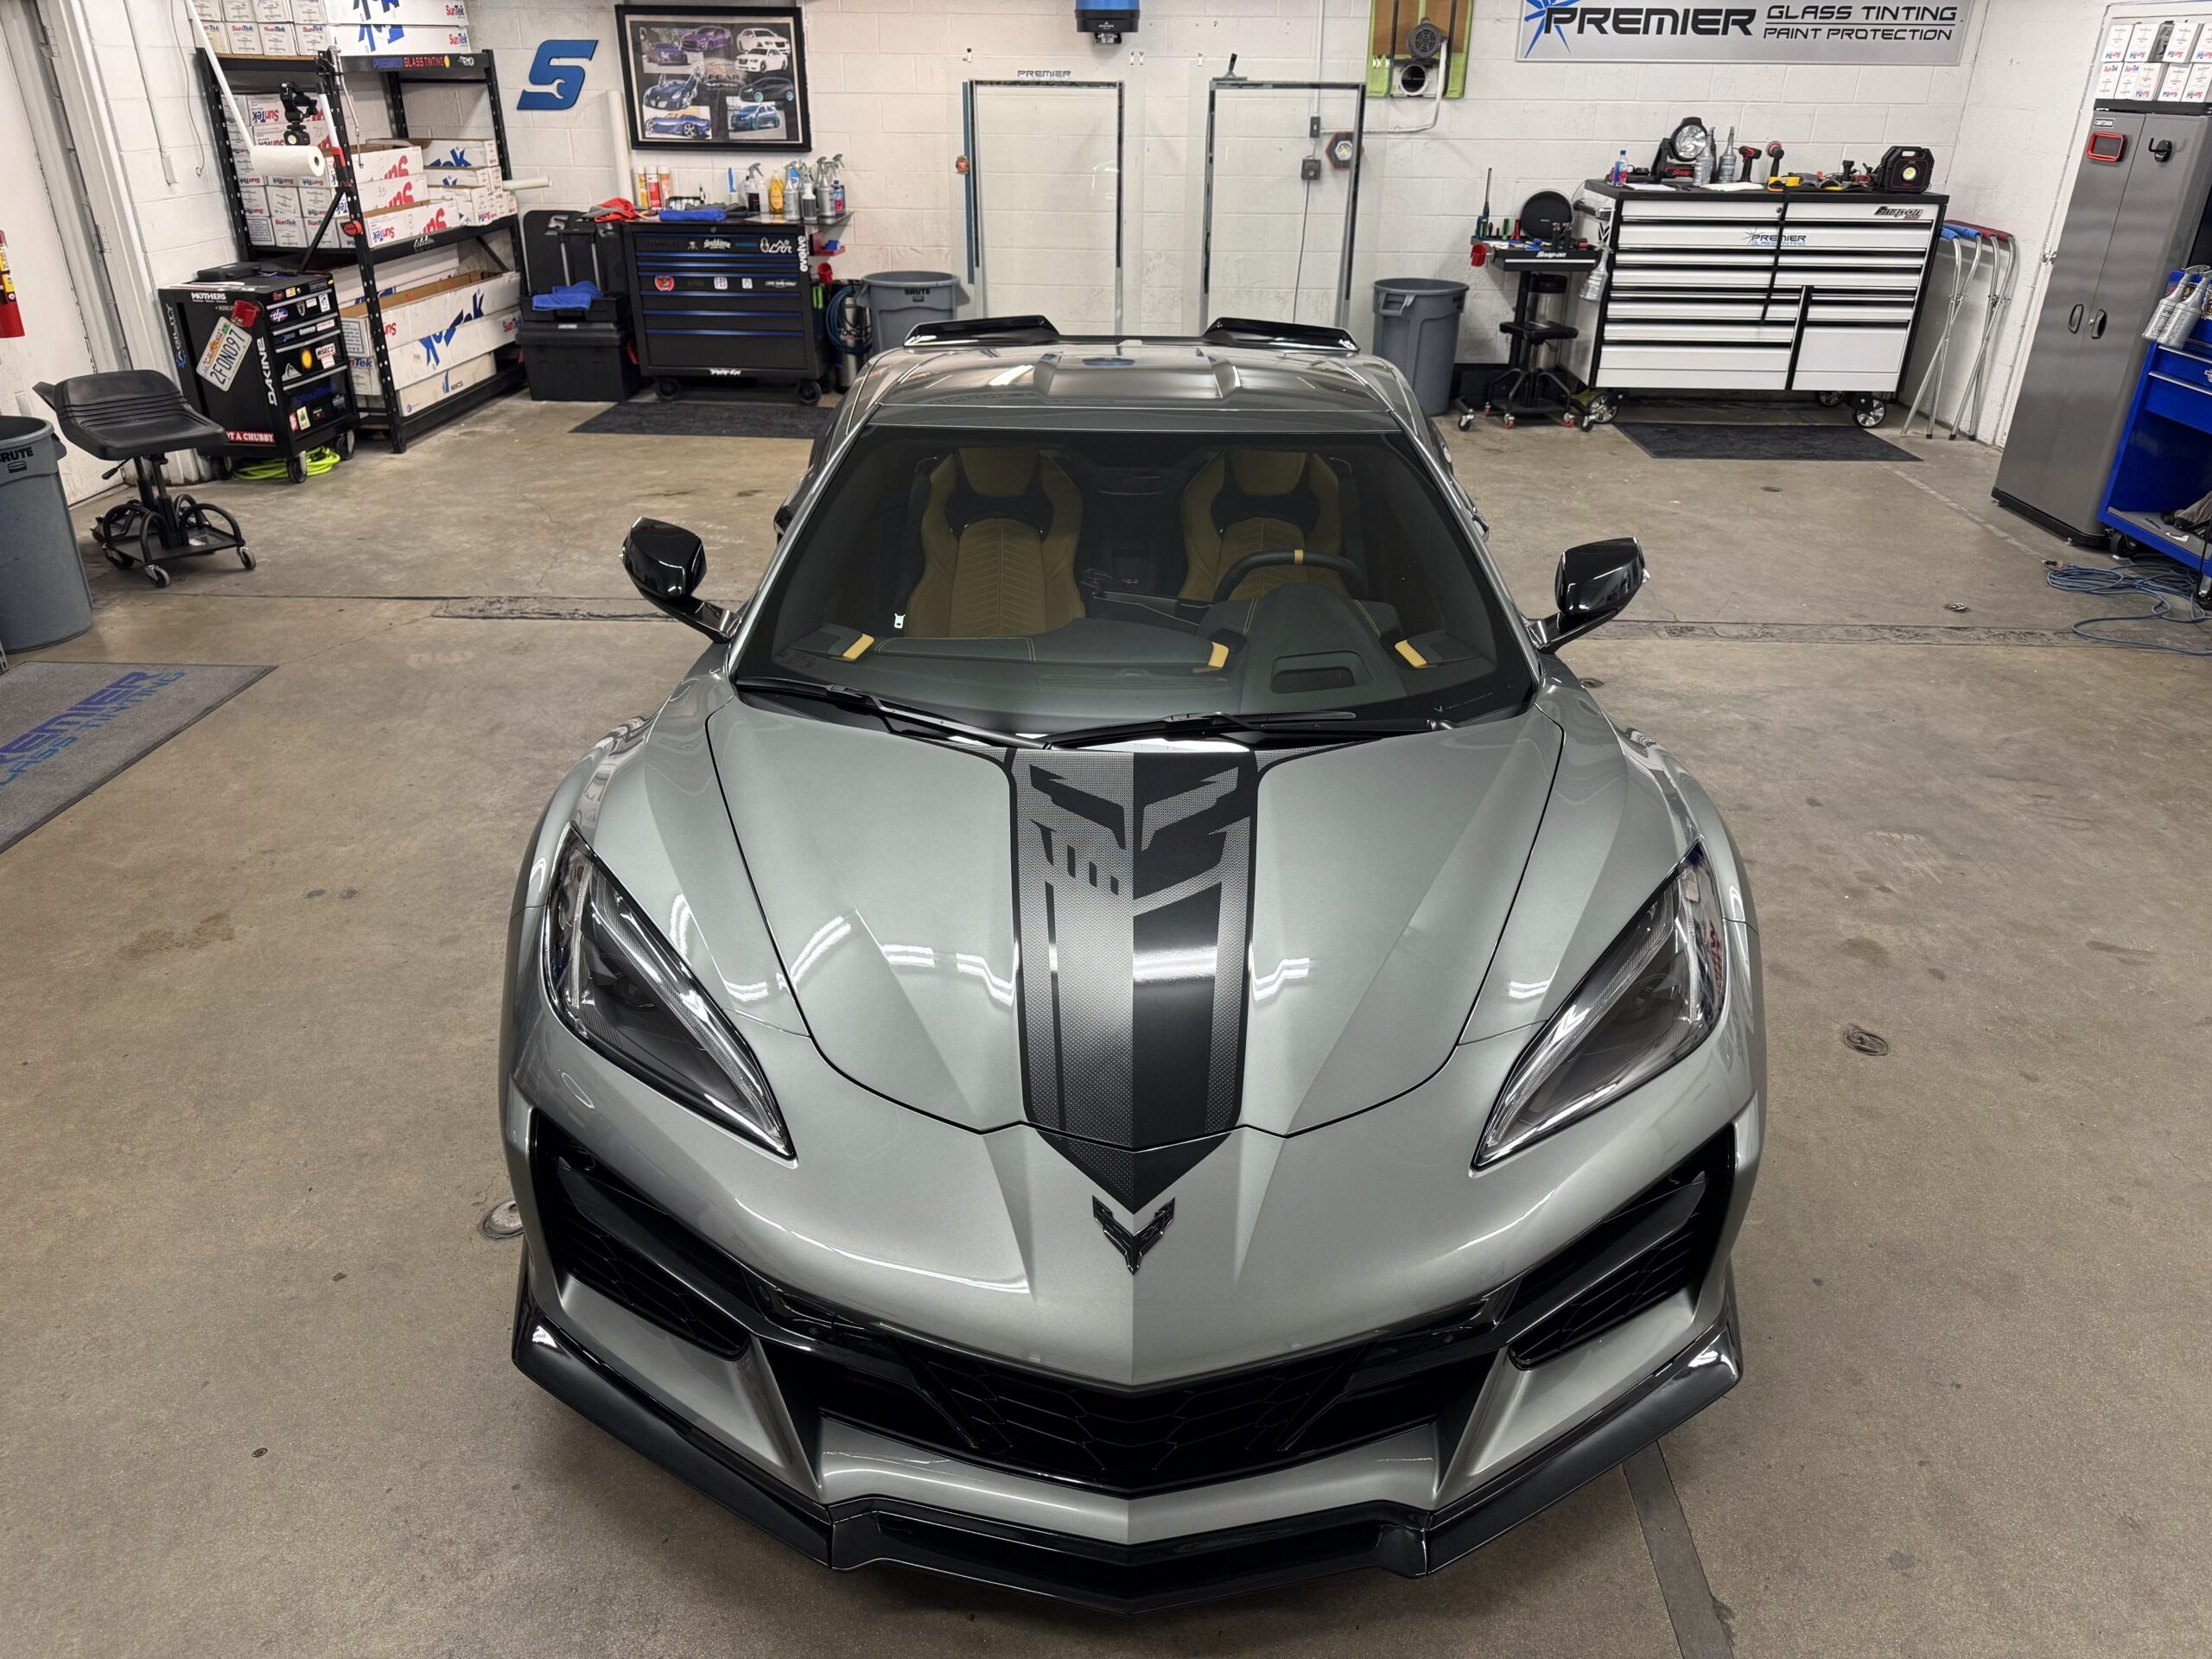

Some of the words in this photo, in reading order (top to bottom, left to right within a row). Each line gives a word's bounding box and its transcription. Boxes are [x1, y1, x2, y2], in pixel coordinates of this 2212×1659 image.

[445, 4, 465, 16] SunTek
[1766, 5, 1853, 20] GLASS
[1860, 6, 1958, 21] TINTING
[1543, 7, 1757, 36] PREMIER
[448, 34, 467, 46] SunTek
[1764, 28, 1822, 40] PAINT
[1827, 29, 1953, 41] PROTECTION
[251, 109, 279, 124] SunTek
[1874, 207, 1923, 218] Snap-on
[372, 226, 395, 243] SunTek
[798, 235, 809, 272] evolve
[257, 336, 277, 406] DAKINE
[243, 433, 275, 442] CHUBBY
[0, 447, 34, 463] RUTE
